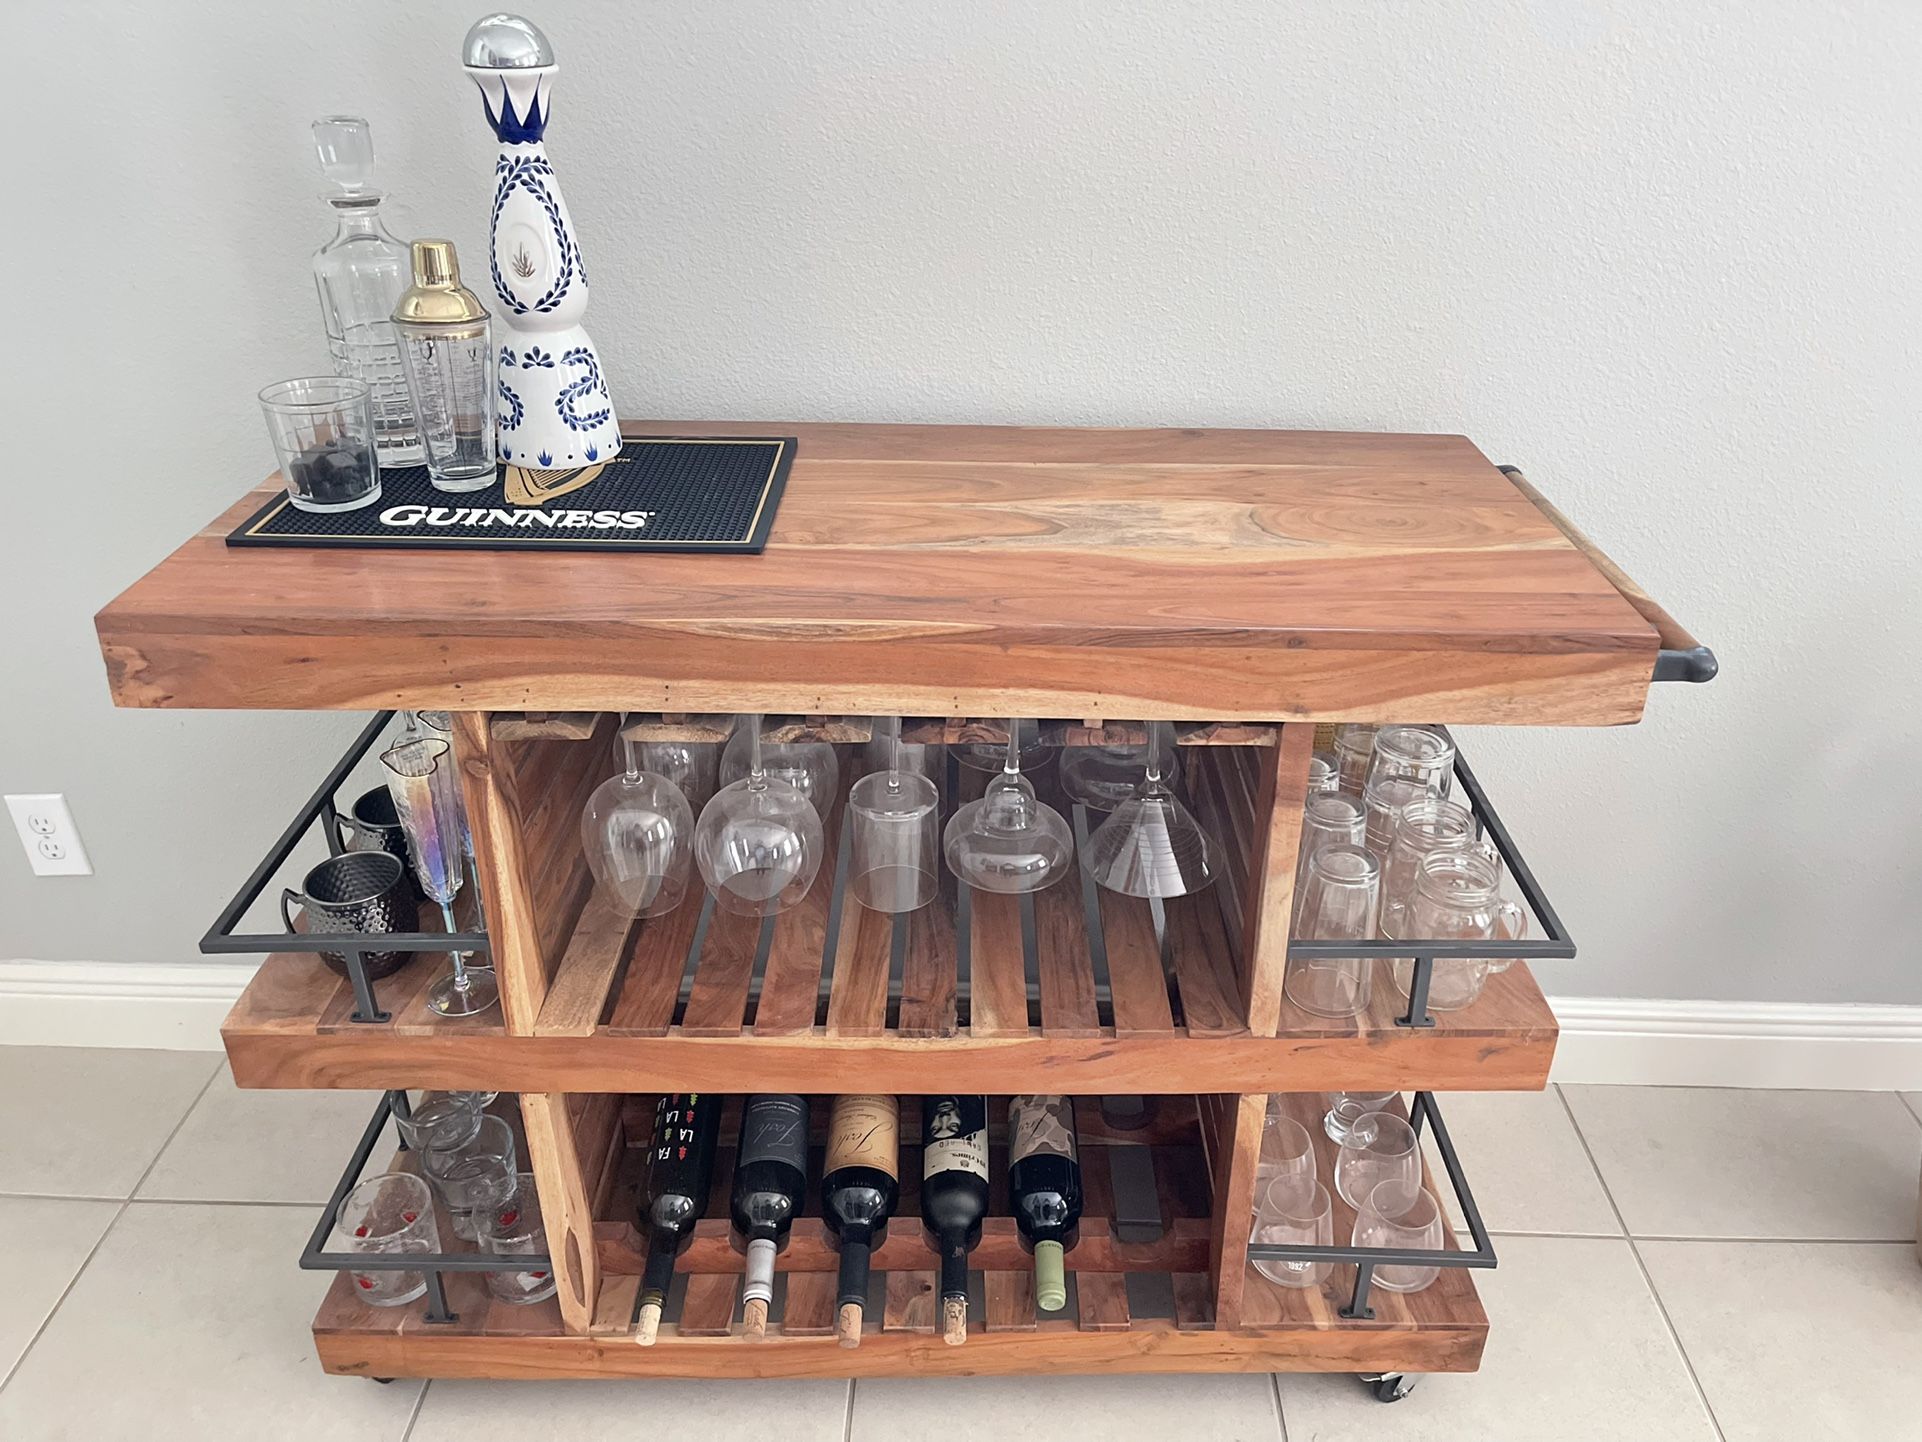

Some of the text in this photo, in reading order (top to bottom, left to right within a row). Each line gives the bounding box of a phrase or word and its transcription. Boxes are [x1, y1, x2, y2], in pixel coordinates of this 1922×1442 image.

[379, 505, 649, 529] GUINNESS
[666, 1110, 679, 1123] LA
[679, 1128, 694, 1143] LA
[658, 1146, 671, 1160] FA
